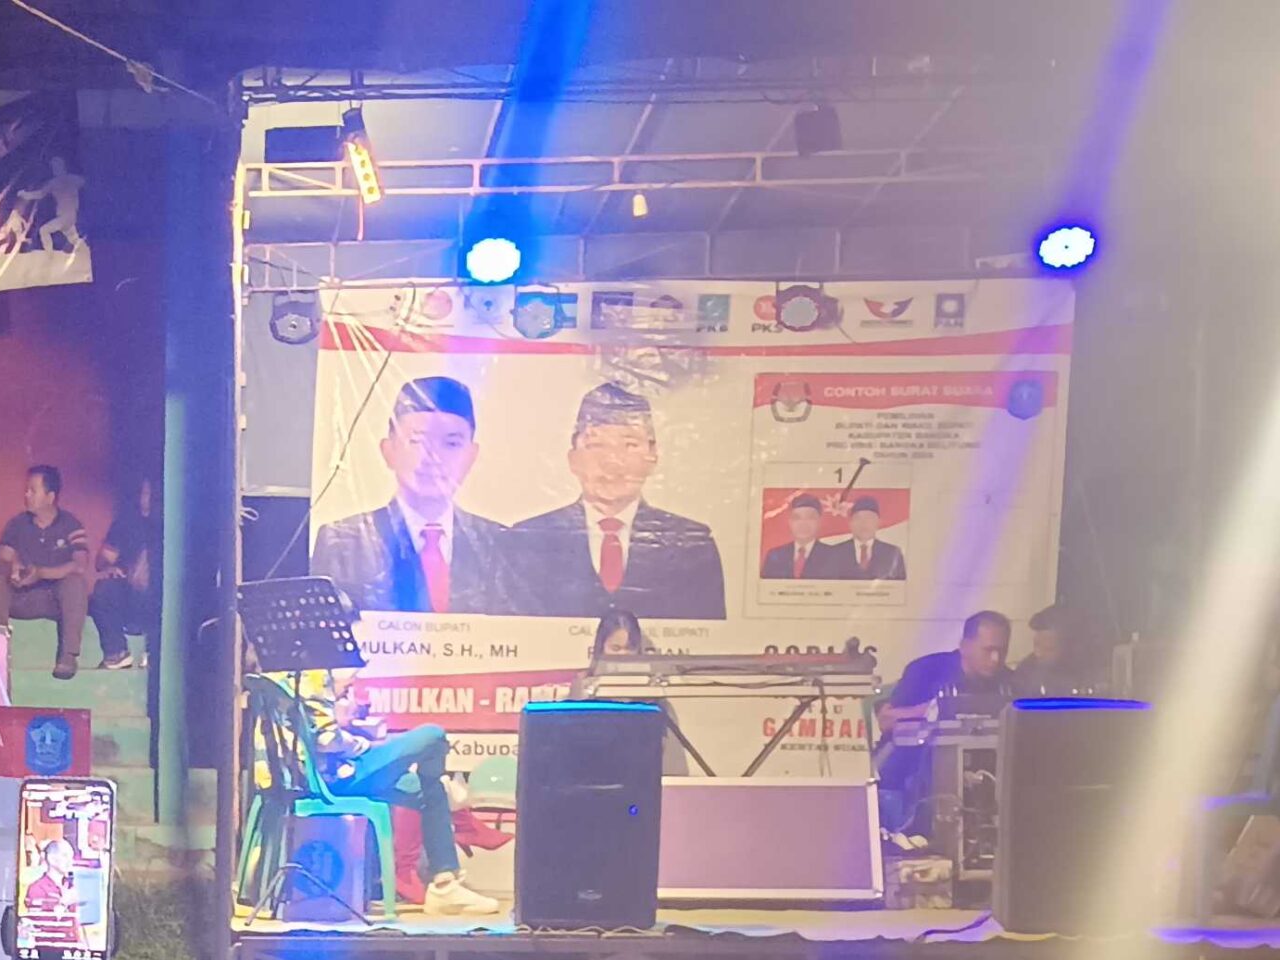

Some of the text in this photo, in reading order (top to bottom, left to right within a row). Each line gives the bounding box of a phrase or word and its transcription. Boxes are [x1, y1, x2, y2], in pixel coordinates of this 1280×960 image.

[751, 323, 784, 333] PKS
[823, 386, 887, 398] CONTOH
[833, 467, 843, 484] 1
[377, 620, 471, 633] CALON BUPATI
[489, 644, 519, 658] MH
[367, 686, 475, 714] MULKAN
